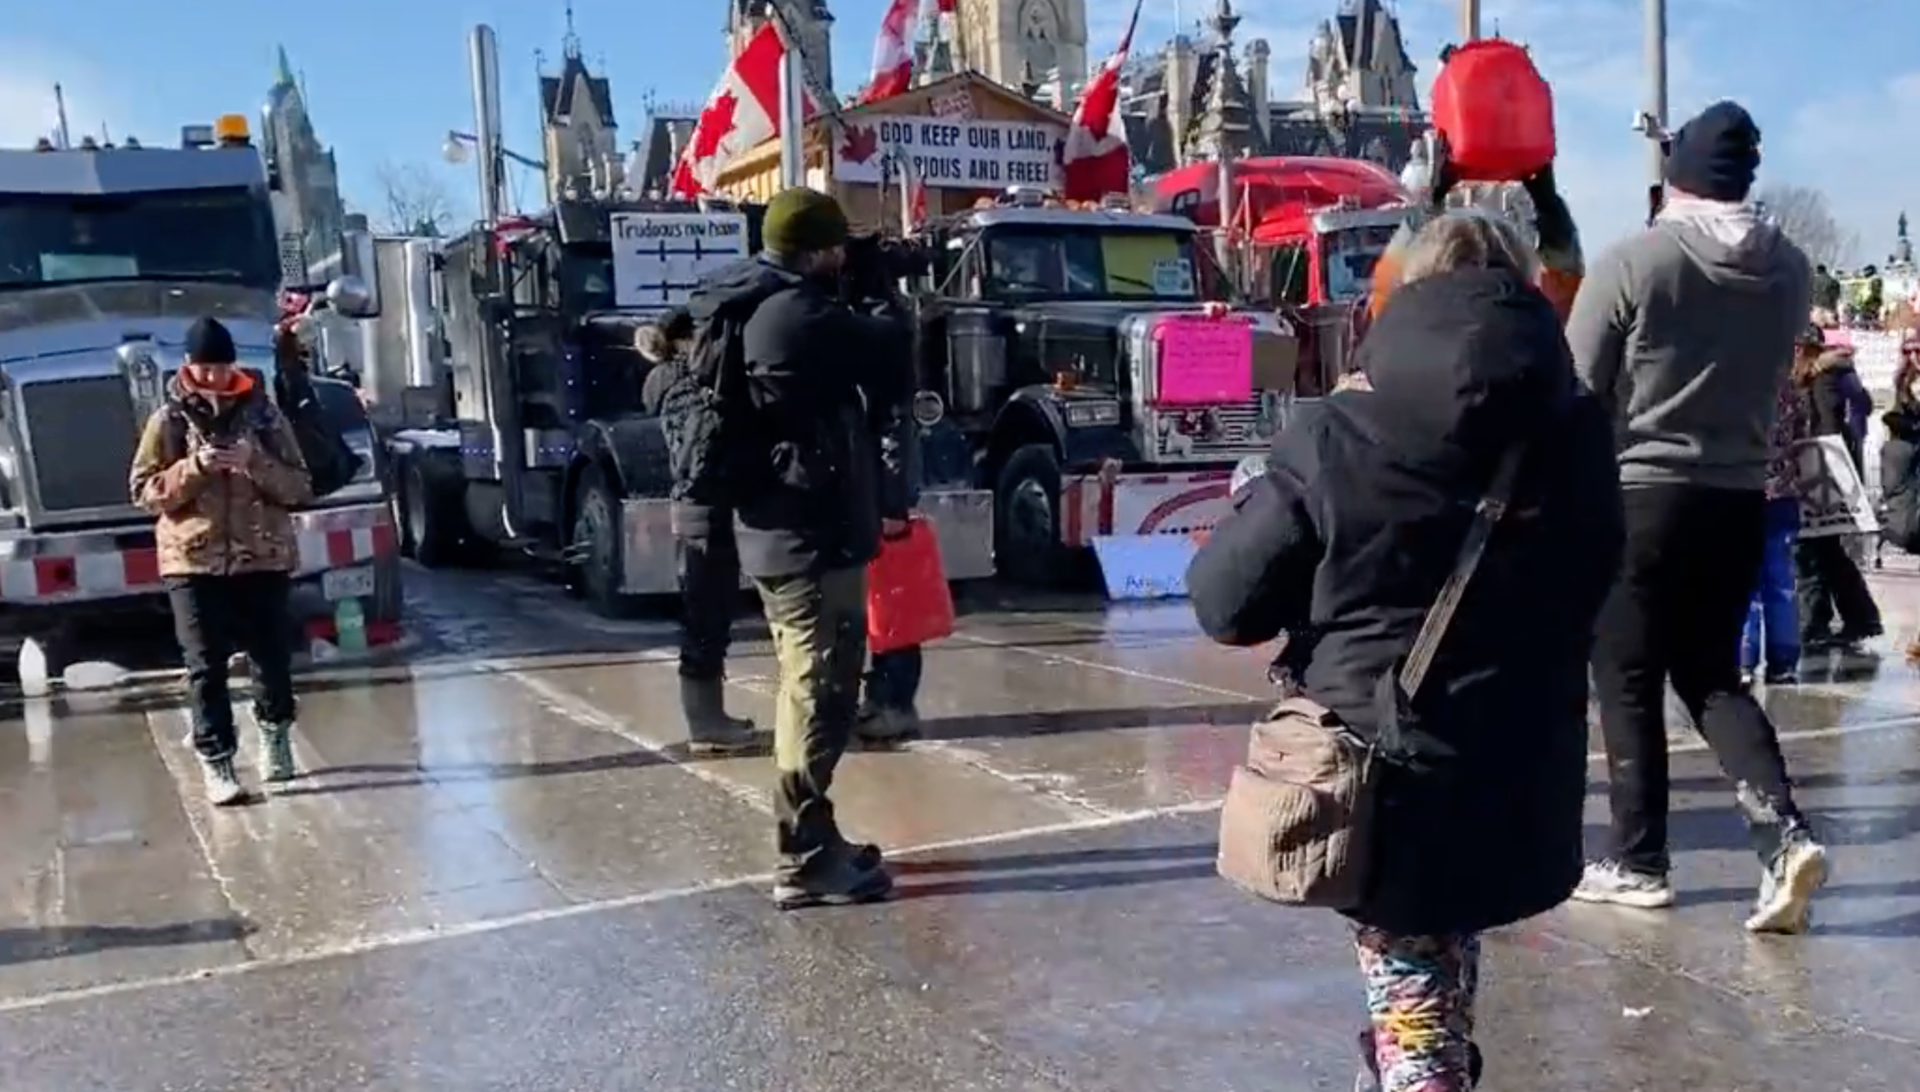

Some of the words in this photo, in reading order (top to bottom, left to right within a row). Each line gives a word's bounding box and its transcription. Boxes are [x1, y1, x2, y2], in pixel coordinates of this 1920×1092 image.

[881, 121, 912, 144] GOD
[921, 124, 960, 147] KEEP
[968, 127, 1000, 149] OUR
[1008, 128, 1051, 153] LAND,
[881, 153, 961, 179] GLRIOUS
[969, 159, 999, 180] AND
[1008, 161, 1048, 182] FREE!
